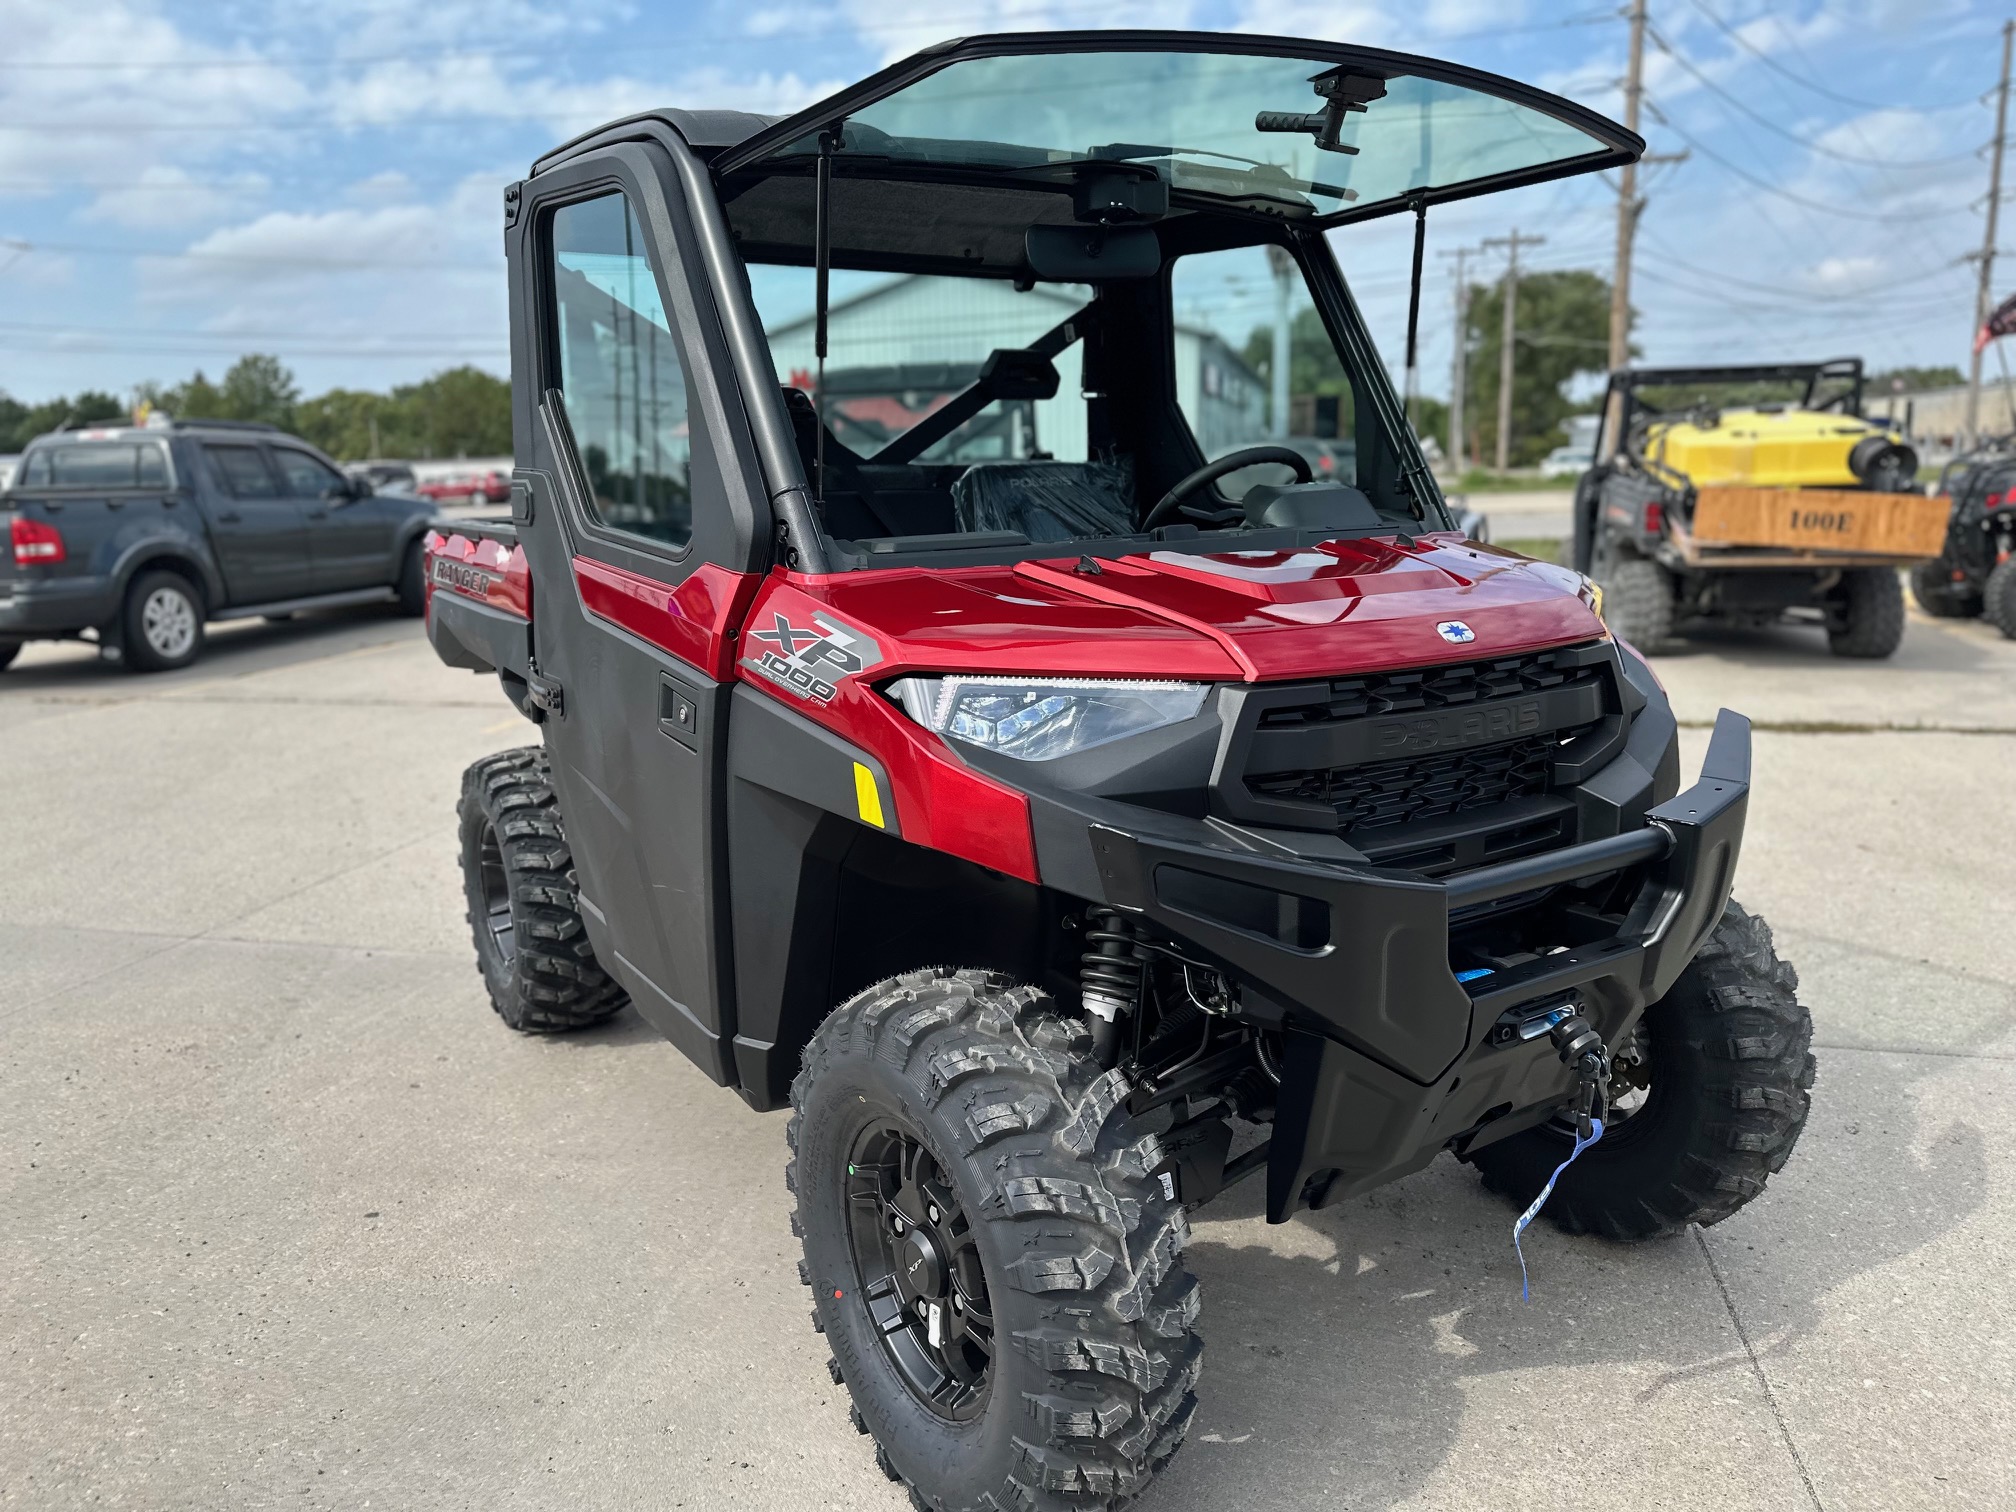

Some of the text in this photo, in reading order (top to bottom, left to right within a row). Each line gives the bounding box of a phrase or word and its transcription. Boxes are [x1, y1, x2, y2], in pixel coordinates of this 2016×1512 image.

[1790, 509, 1855, 533] 100E
[435, 561, 490, 595] RANGER
[747, 612, 863, 675] XP
[757, 667, 828, 708] DUAL OVERHEAD CAM
[760, 650, 838, 702] 1000
[1374, 702, 1541, 754] POLARIS
[1163, 1128, 1210, 1157] ARIS
[908, 1258, 924, 1275] XP
